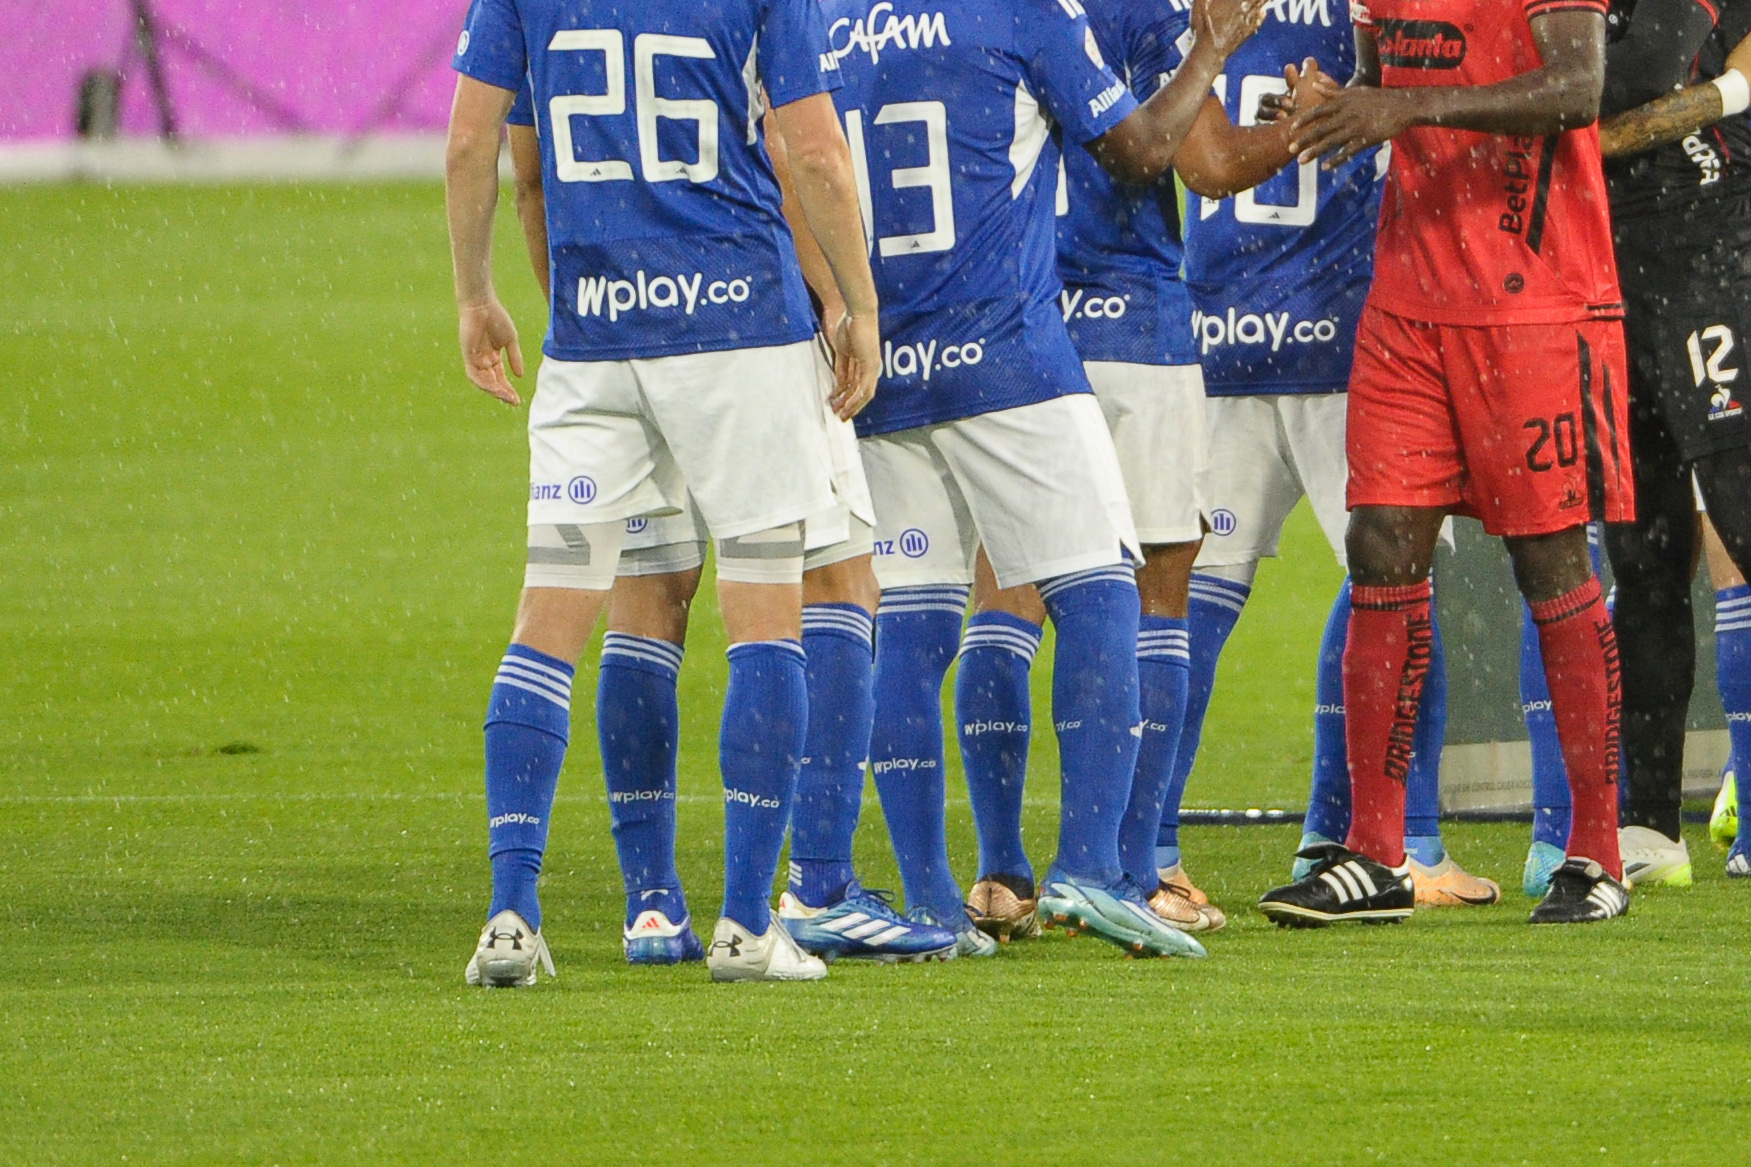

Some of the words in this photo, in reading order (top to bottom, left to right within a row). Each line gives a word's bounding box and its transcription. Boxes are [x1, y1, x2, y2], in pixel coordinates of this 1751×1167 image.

[548, 29, 719, 183] 26
[845, 100, 956, 258] 13
[879, 339, 984, 380] lay.co
[1686, 324, 1739, 388] 12
[1523, 411, 1579, 472] 20
[724, 786, 781, 809] play.co
